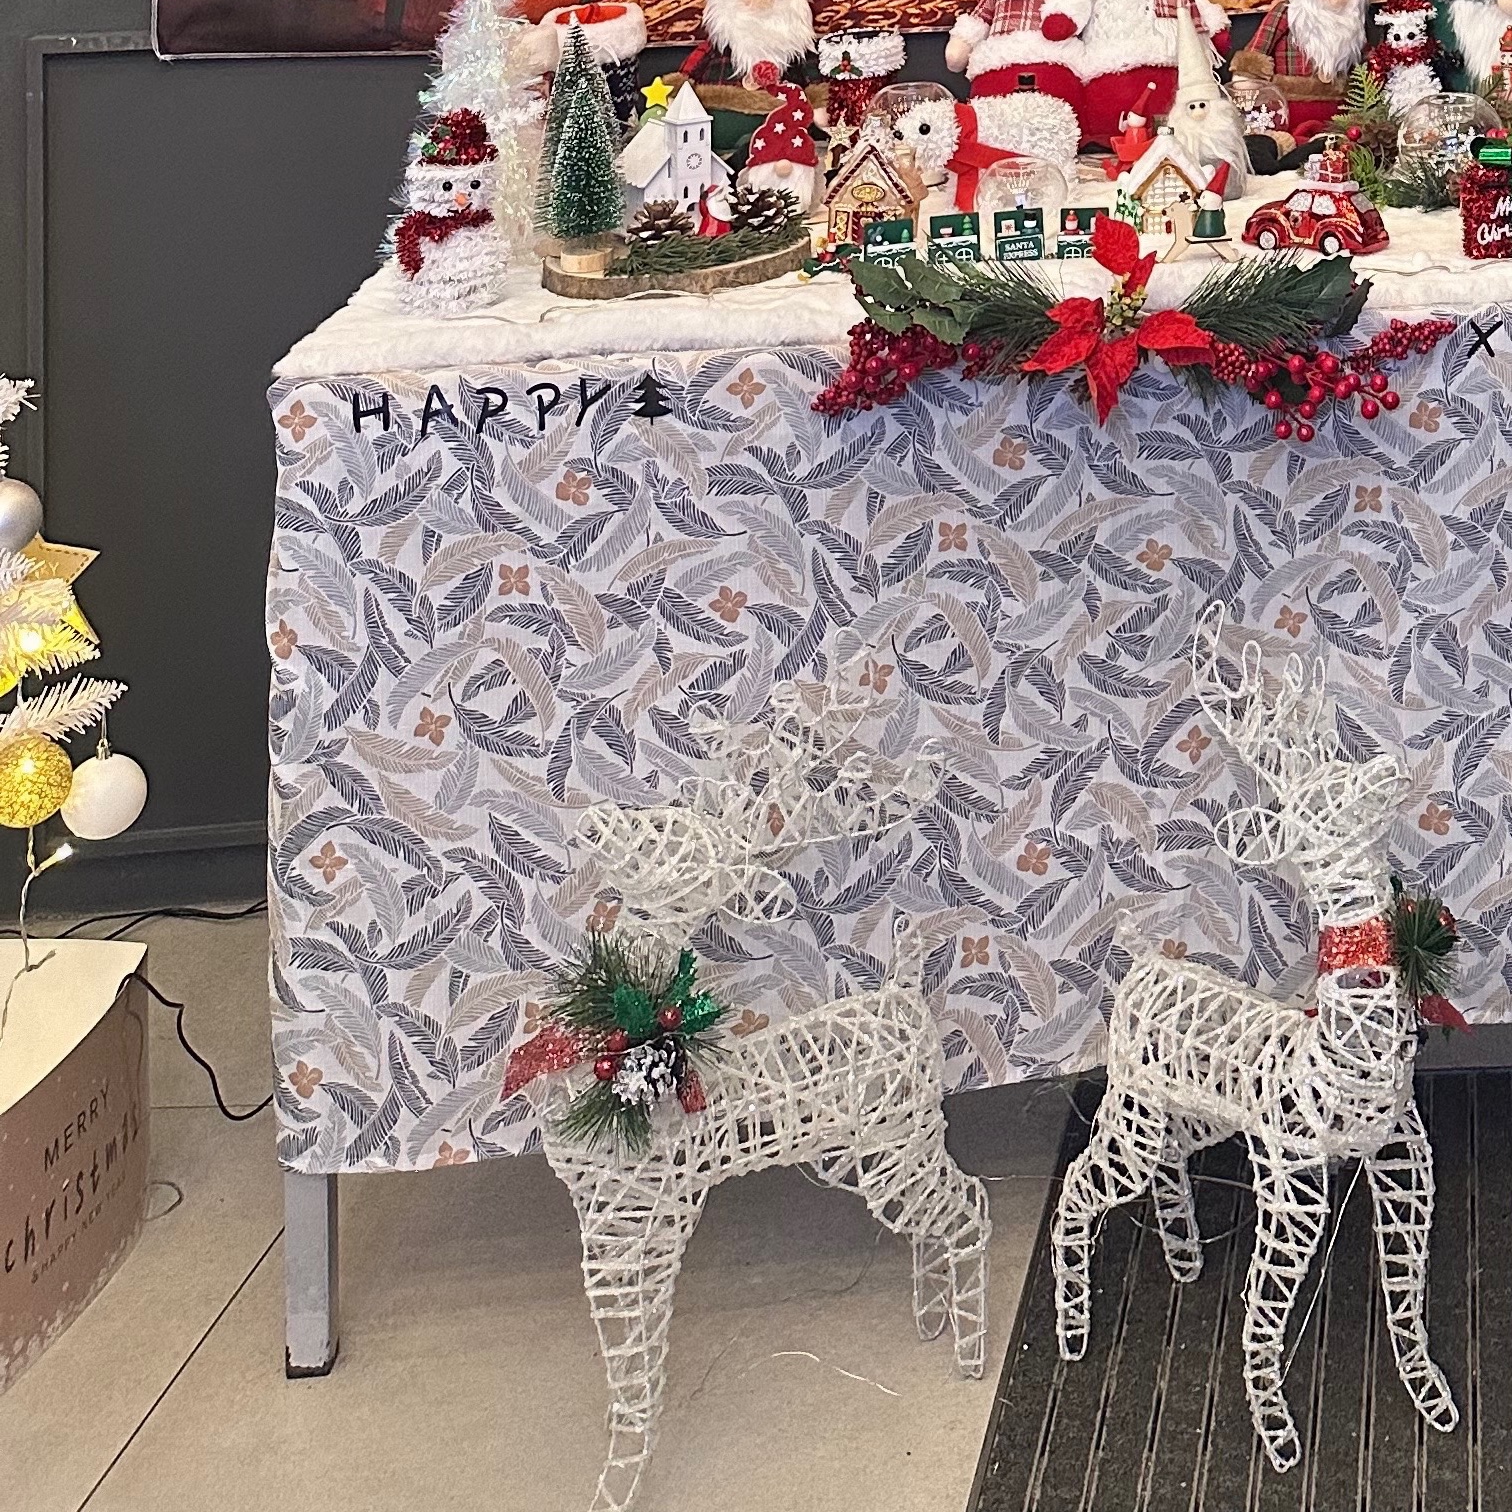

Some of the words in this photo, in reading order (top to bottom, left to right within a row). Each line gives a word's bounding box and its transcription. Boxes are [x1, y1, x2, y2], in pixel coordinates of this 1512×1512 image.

[1003, 249, 1038, 259] EXPRESS
[1004, 241, 1035, 251] SANTA
[352, 376, 612, 437] HAPPY
[43, 1077, 111, 1173] MERRY
[4, 1103, 139, 1274] christmas
[41, 1229, 77, 1274] HAPPY
[81, 1198, 103, 1233] NEW
